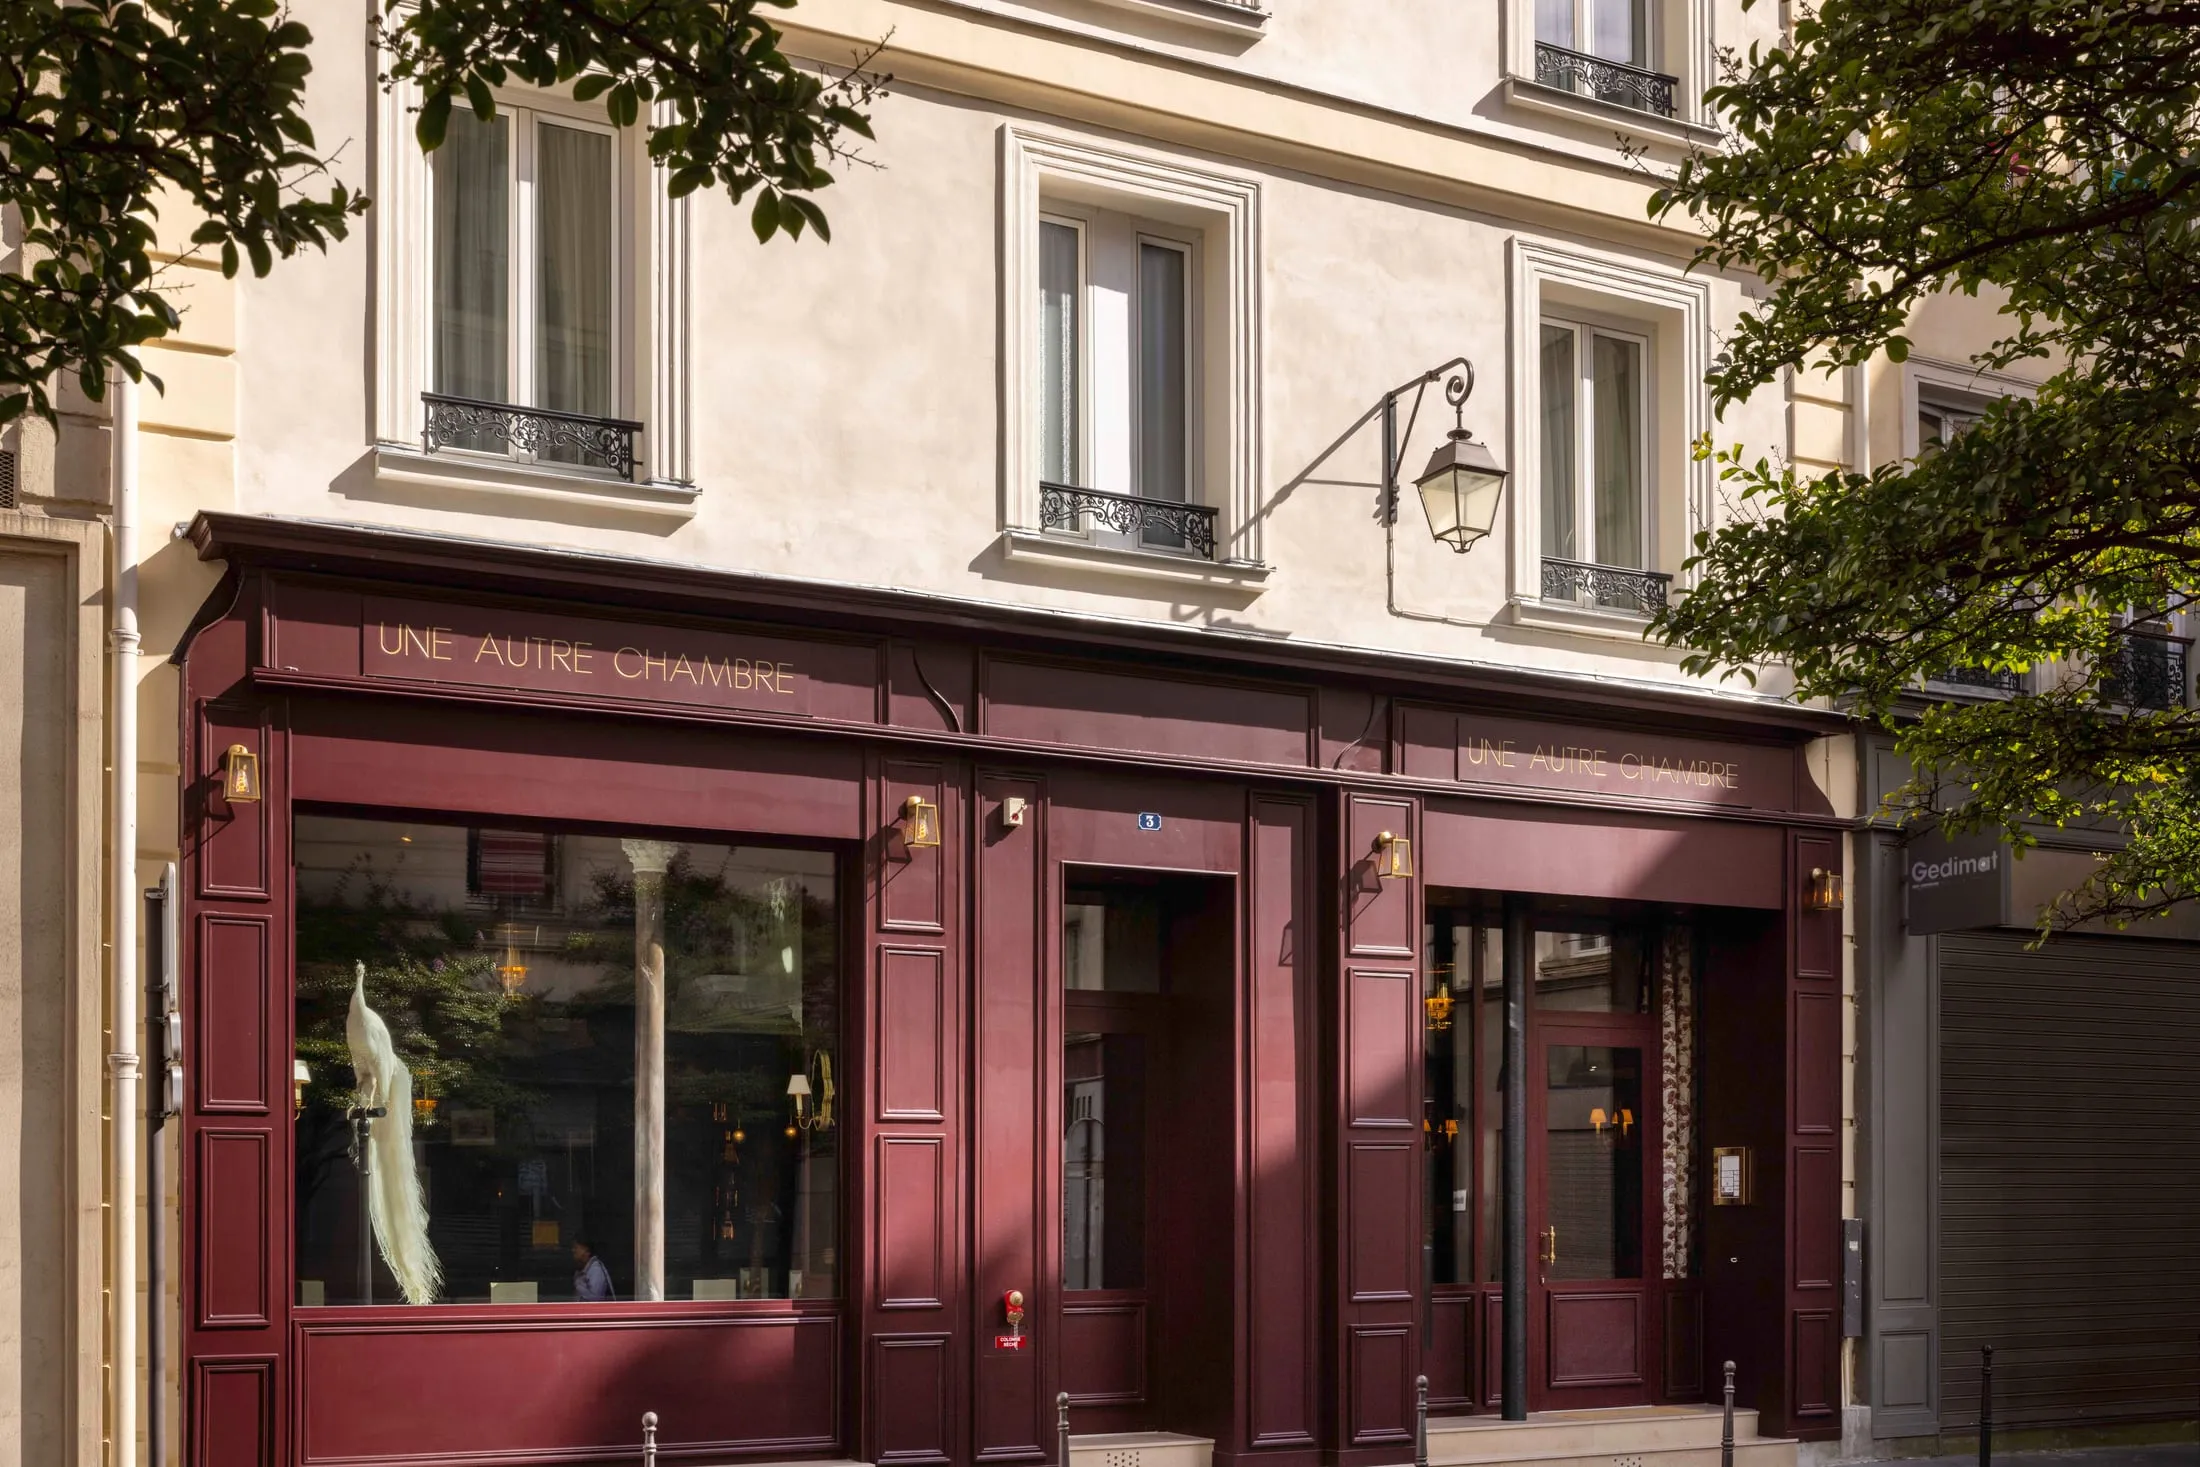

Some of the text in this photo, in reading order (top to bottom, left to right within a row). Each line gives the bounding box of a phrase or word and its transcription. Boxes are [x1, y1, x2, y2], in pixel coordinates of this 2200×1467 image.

[379, 621, 794, 694] UNE AUTRE CHAMBRE
[1468, 736, 1739, 789] UNE AUTRE CHAMBRE
[1146, 815, 1154, 827] 3
[1911, 850, 1998, 882] Gedimat
